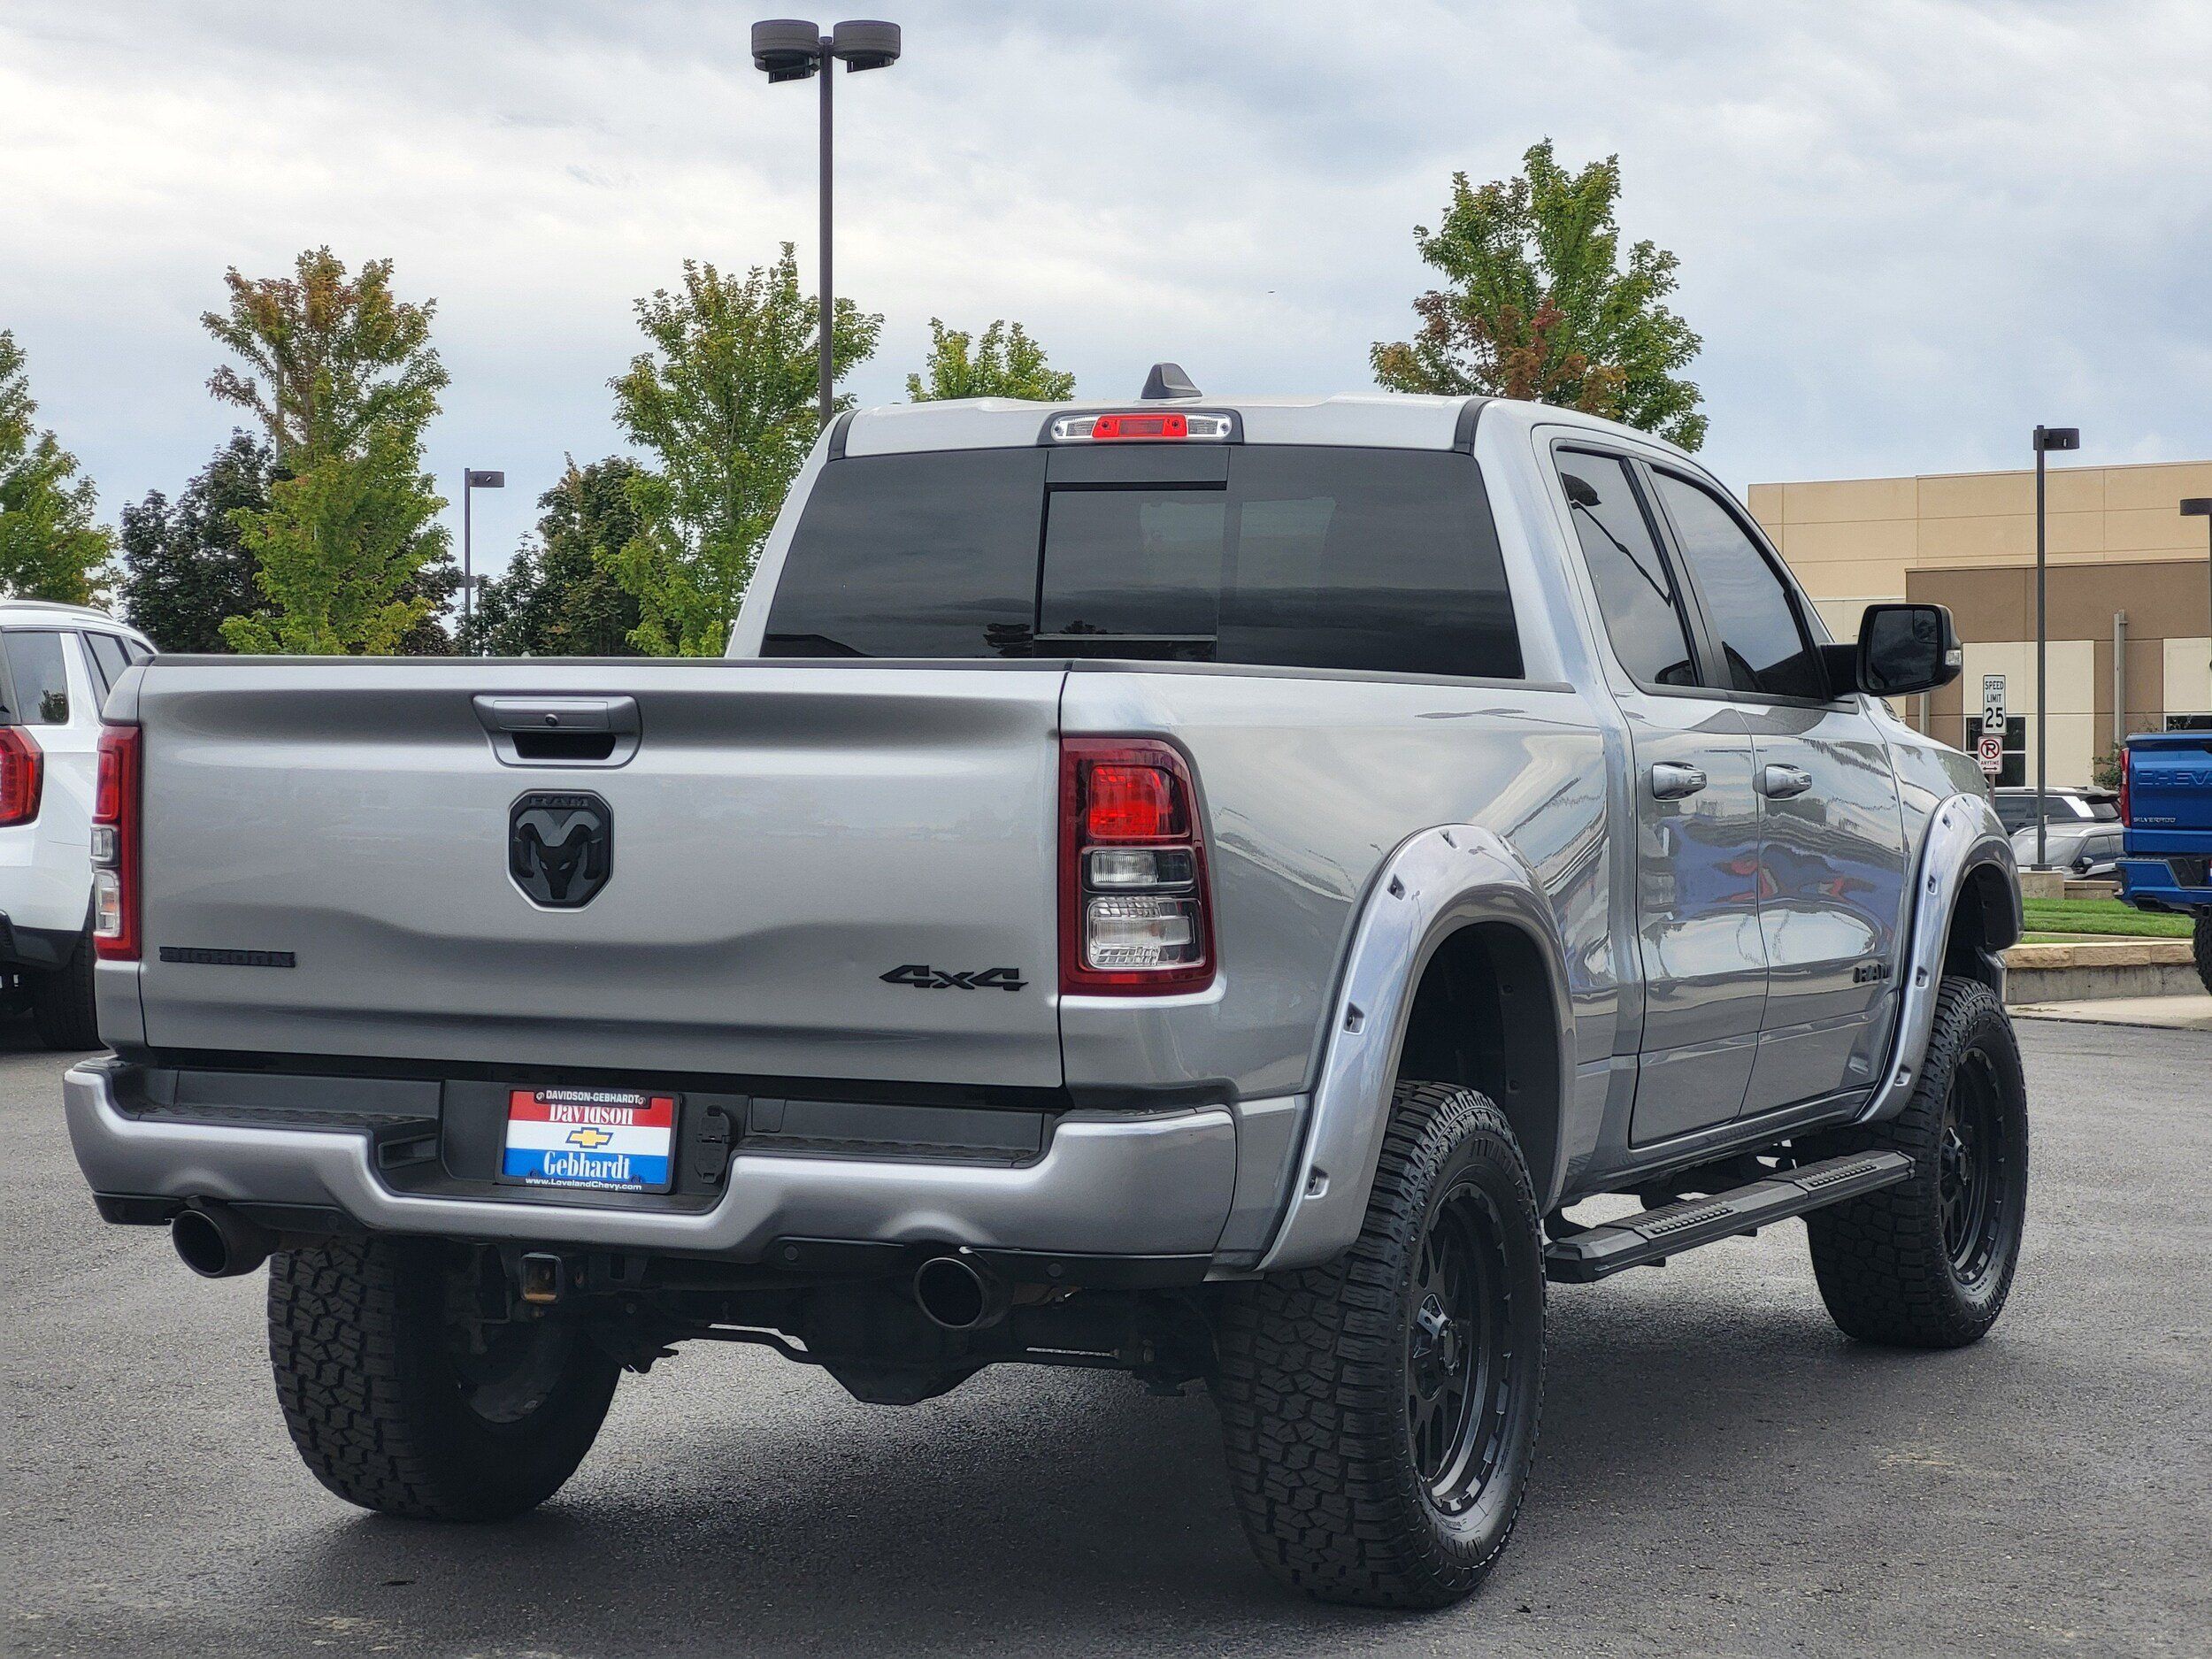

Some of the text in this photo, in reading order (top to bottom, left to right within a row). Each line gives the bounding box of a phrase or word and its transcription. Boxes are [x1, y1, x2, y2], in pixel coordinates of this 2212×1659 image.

[1985, 680, 2004, 690] SPEED
[1986, 694, 2001, 703] LIMIT
[1985, 707, 2004, 728] 25
[529, 796, 589, 807] RAM
[1853, 964, 1891, 983] RAM
[546, 1090, 640, 1103] DAVIDSON-GEBHARDT
[549, 1104, 634, 1125] Davidson
[543, 1150, 630, 1179] Gebhardt
[525, 1177, 642, 1191] www.LovelandChevy.com
